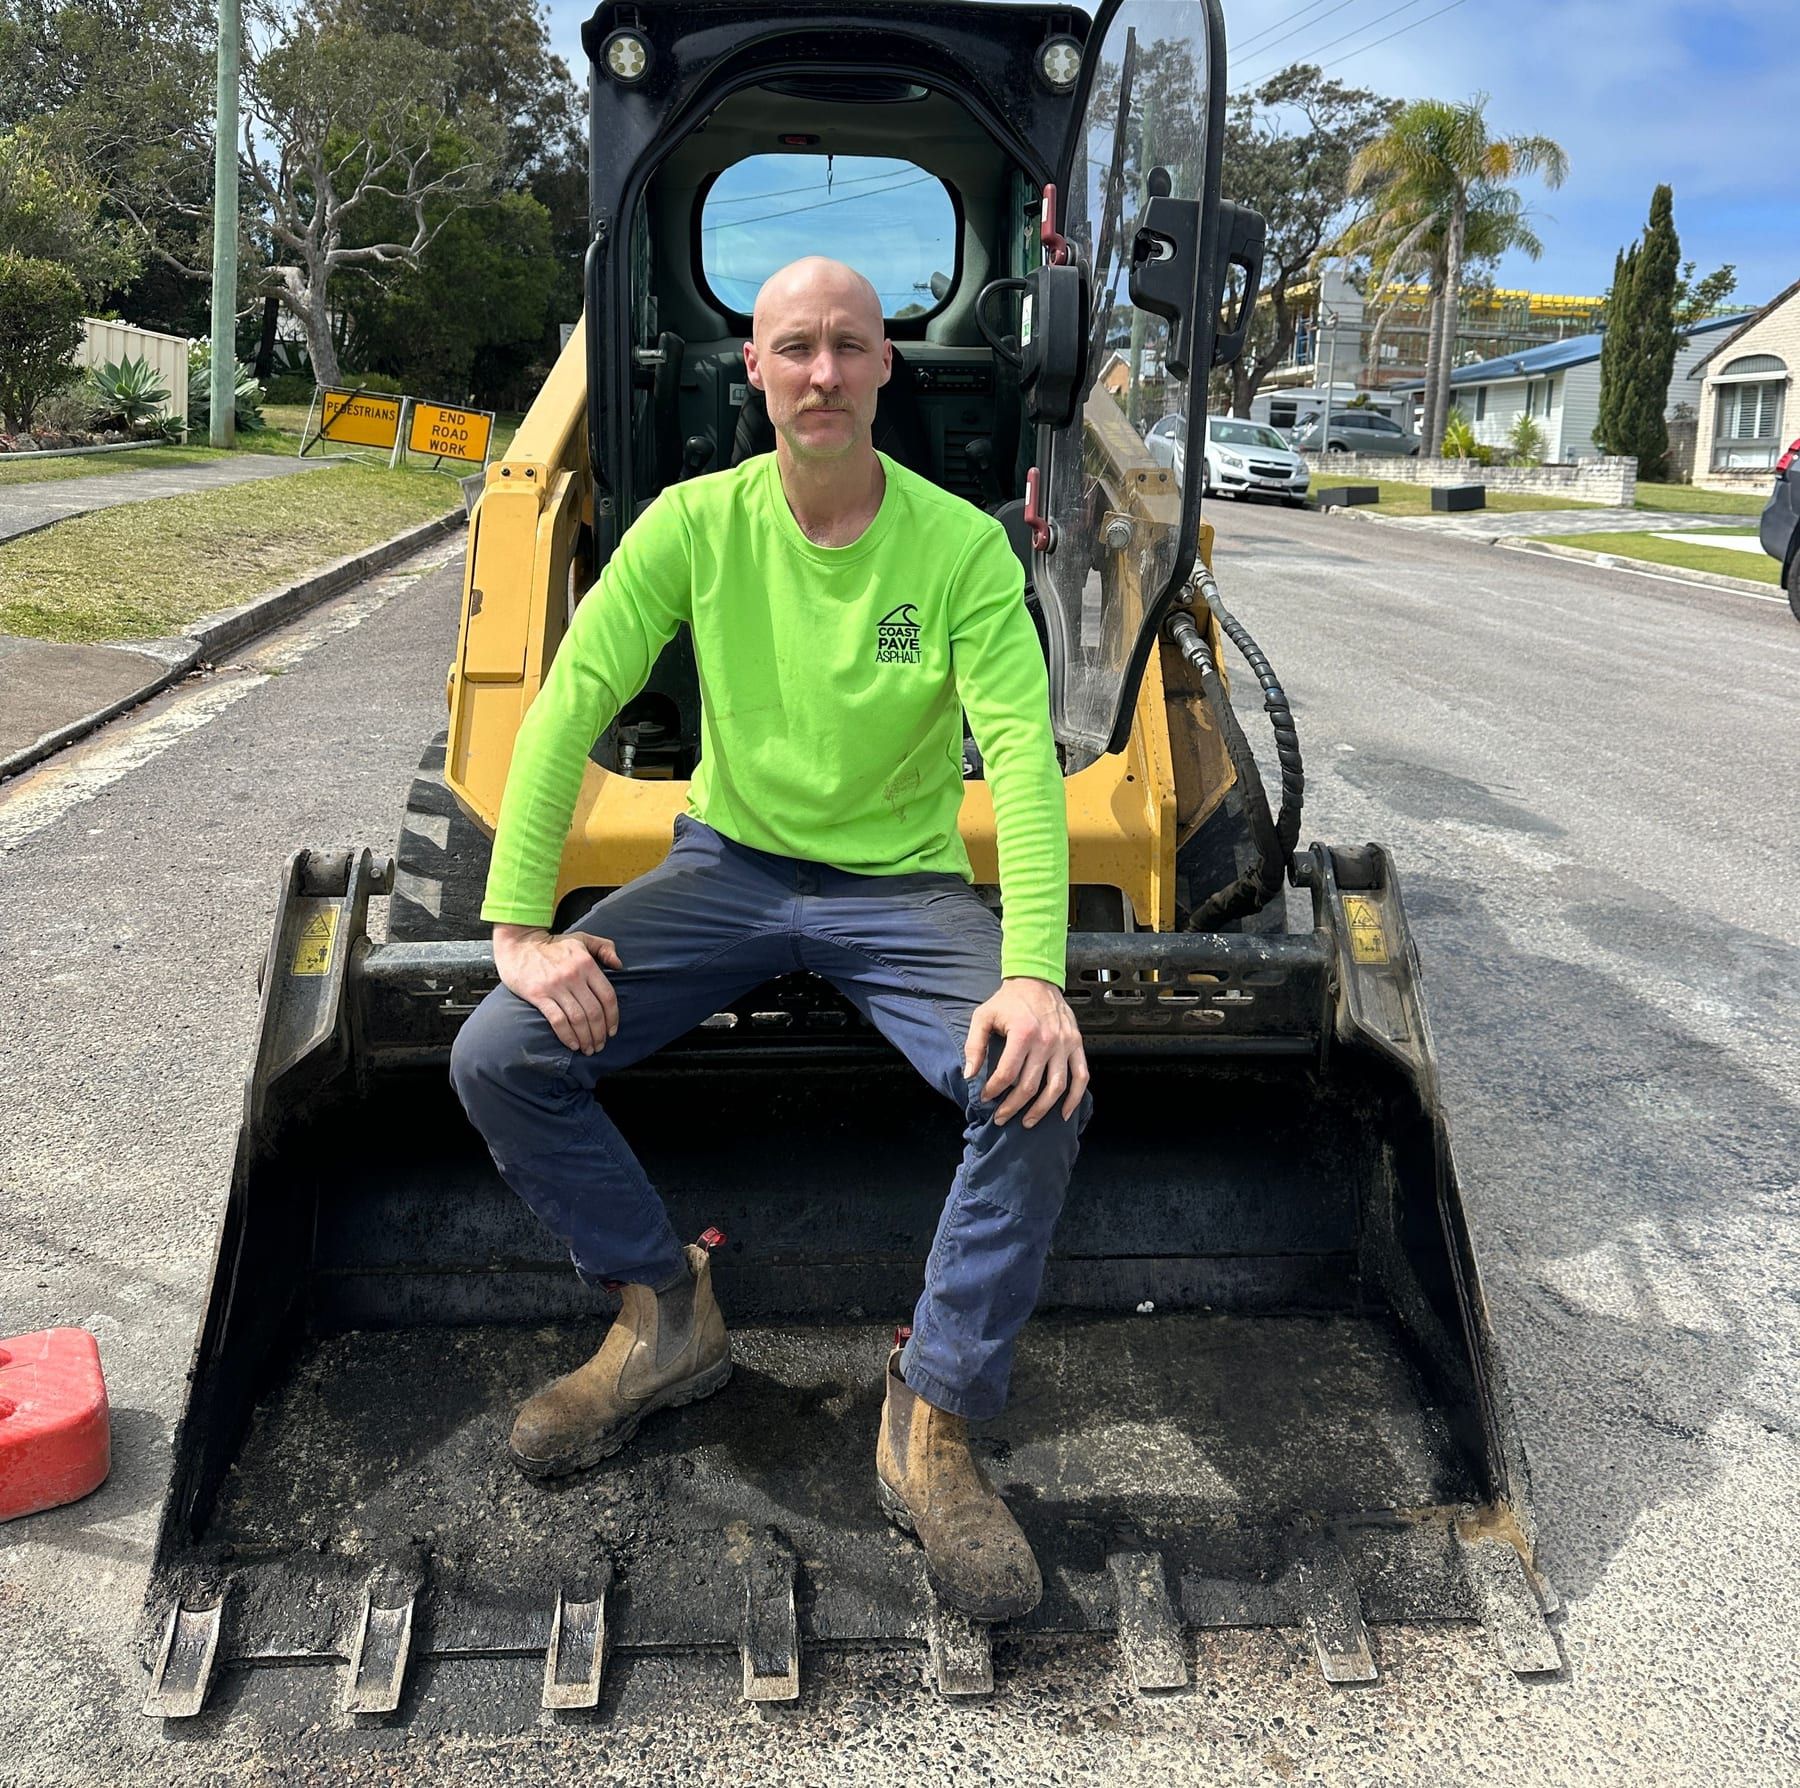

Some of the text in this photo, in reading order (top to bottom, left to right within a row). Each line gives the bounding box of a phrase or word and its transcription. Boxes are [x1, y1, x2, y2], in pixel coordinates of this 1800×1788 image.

[439, 411, 466, 425] END
[432, 425, 468, 441] ROAD
[430, 439, 466, 456] WORK
[878, 627, 920, 638] COAST
[878, 638, 920, 650] PAVE
[875, 650, 922, 664] ASPHALT
